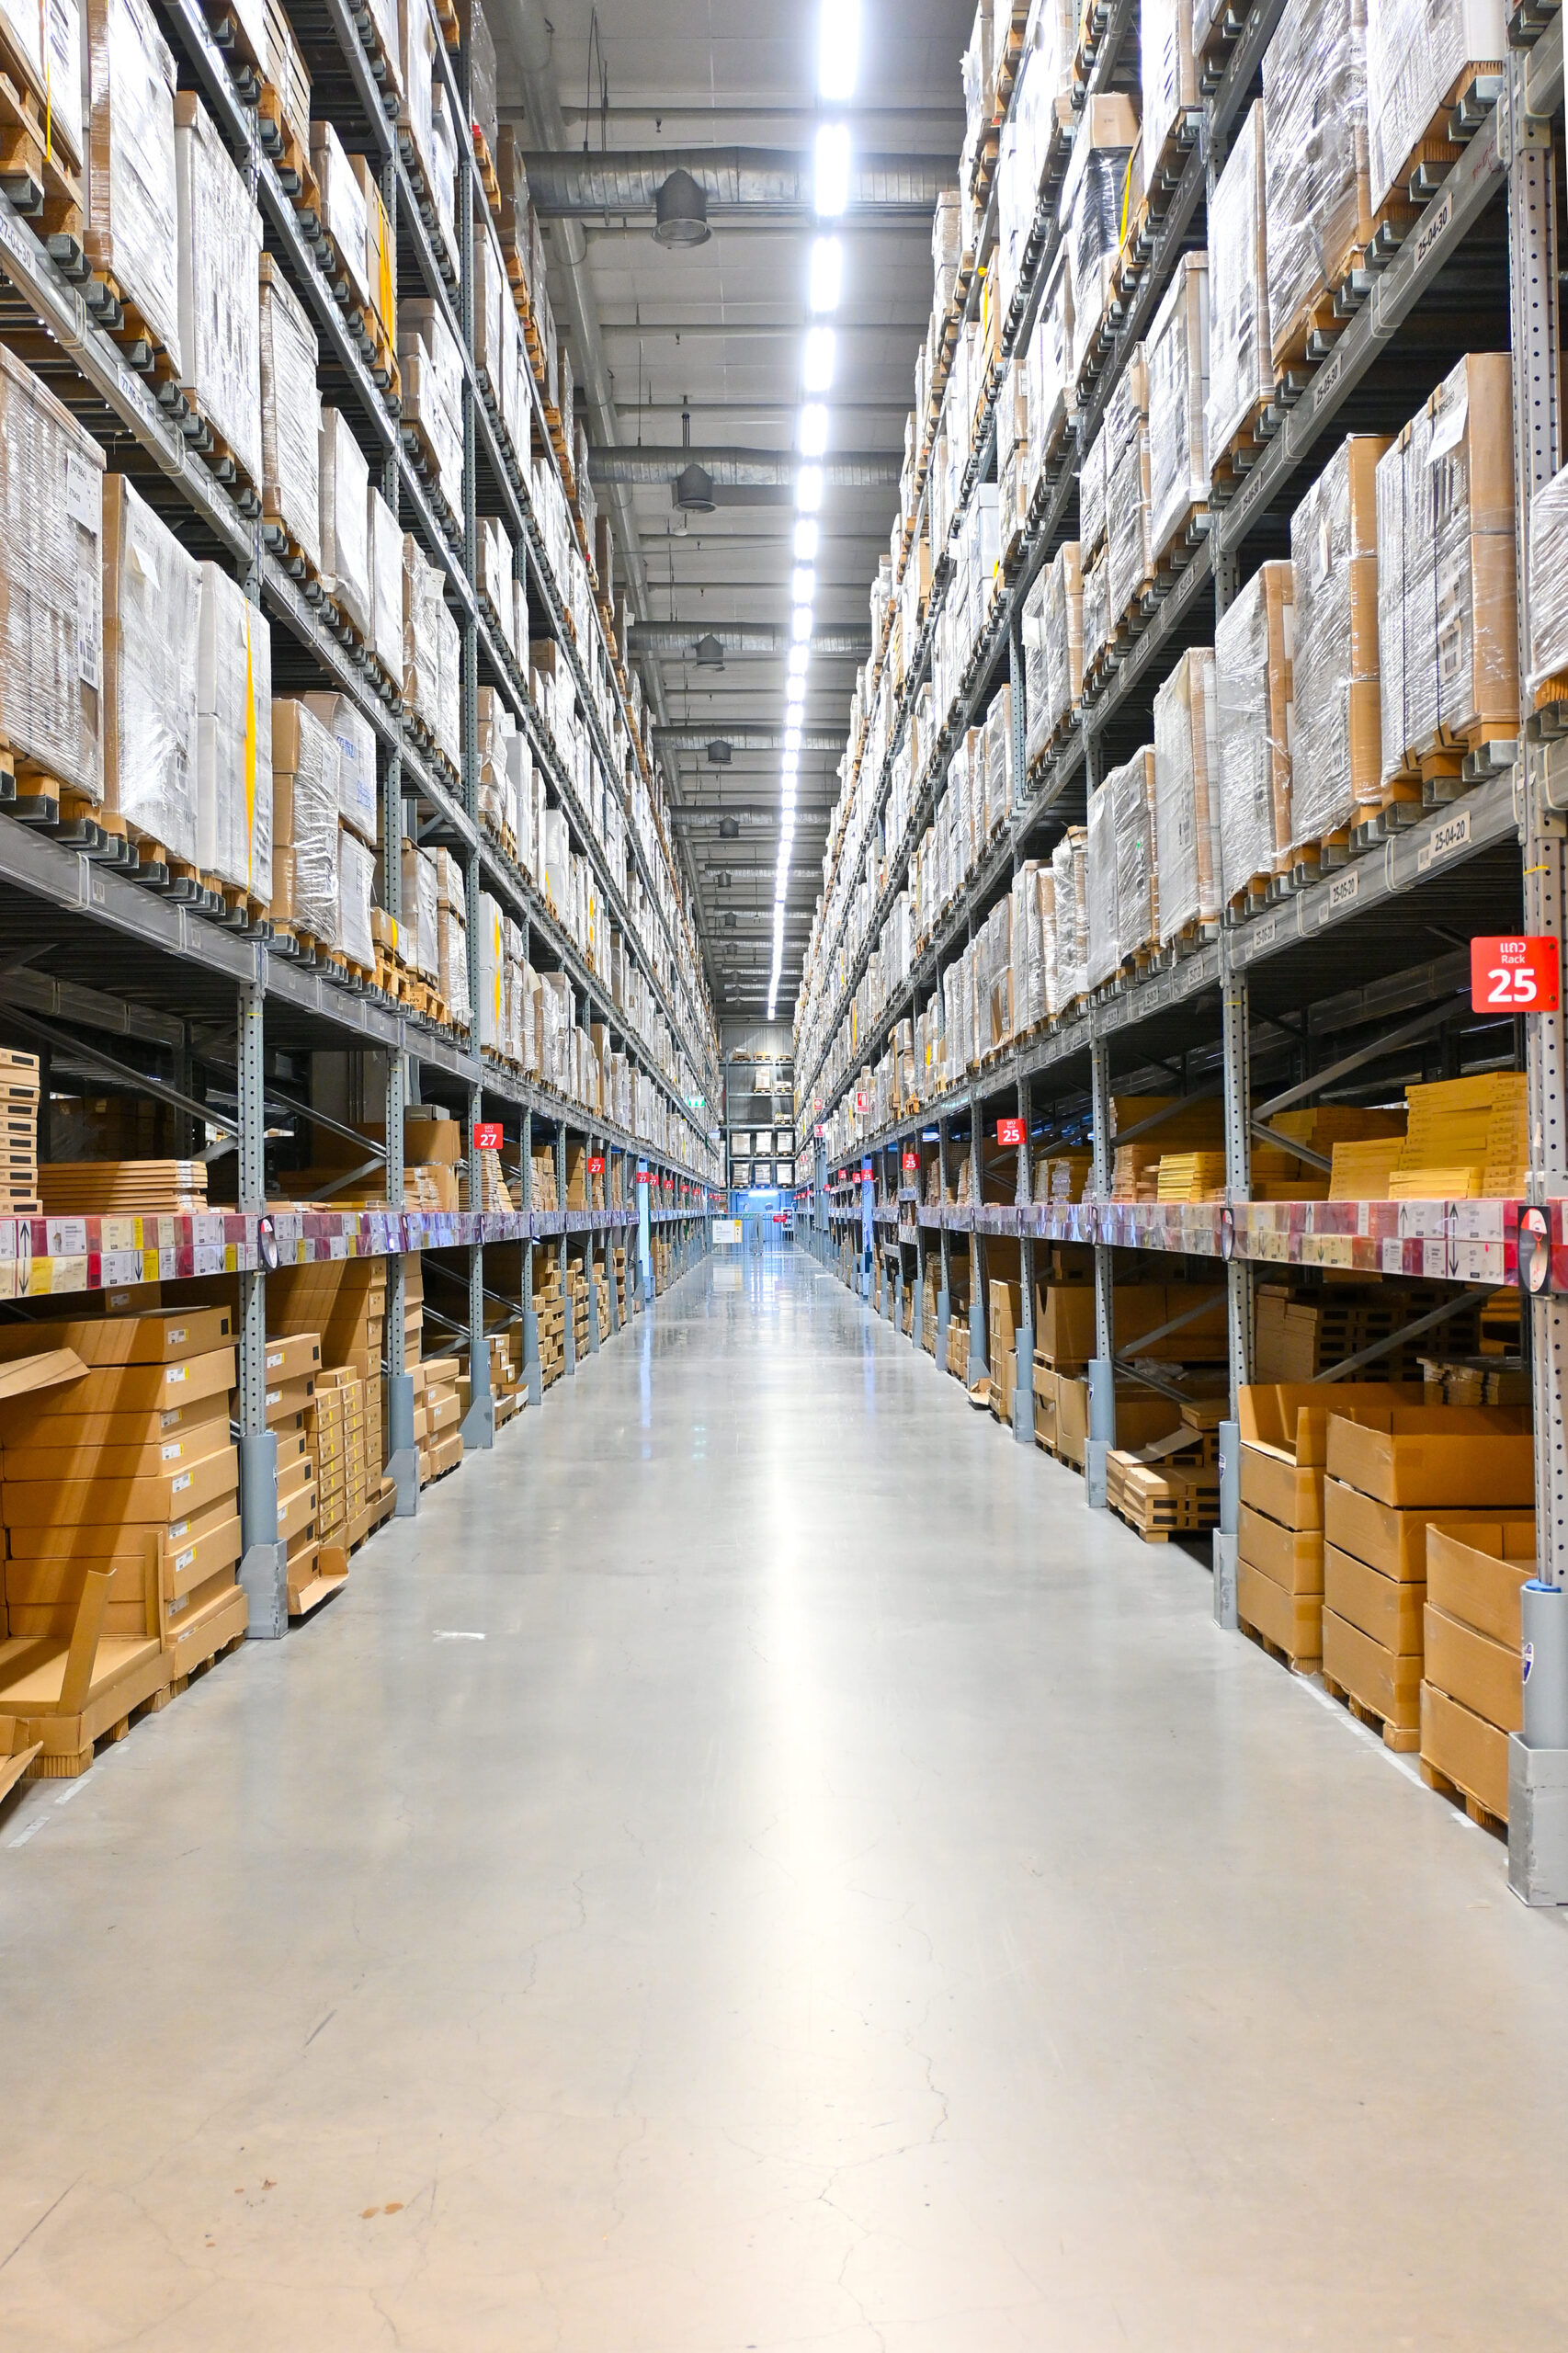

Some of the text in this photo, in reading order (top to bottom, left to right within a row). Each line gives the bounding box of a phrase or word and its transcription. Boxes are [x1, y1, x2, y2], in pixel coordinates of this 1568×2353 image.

[1417, 206, 1449, 262] 25-04-30
[1435, 819, 1465, 852] 25-04-20
[1333, 877, 1355, 904] 25-05-20
[1499, 942, 1527, 953] แถว
[1501, 954, 1526, 964] Rack
[1487, 968, 1538, 1004] 25
[480, 1133, 497, 1146] 27
[1003, 1130, 1020, 1142] 25
[591, 1164, 602, 1172] 27
[905, 1160, 916, 1168] 25
